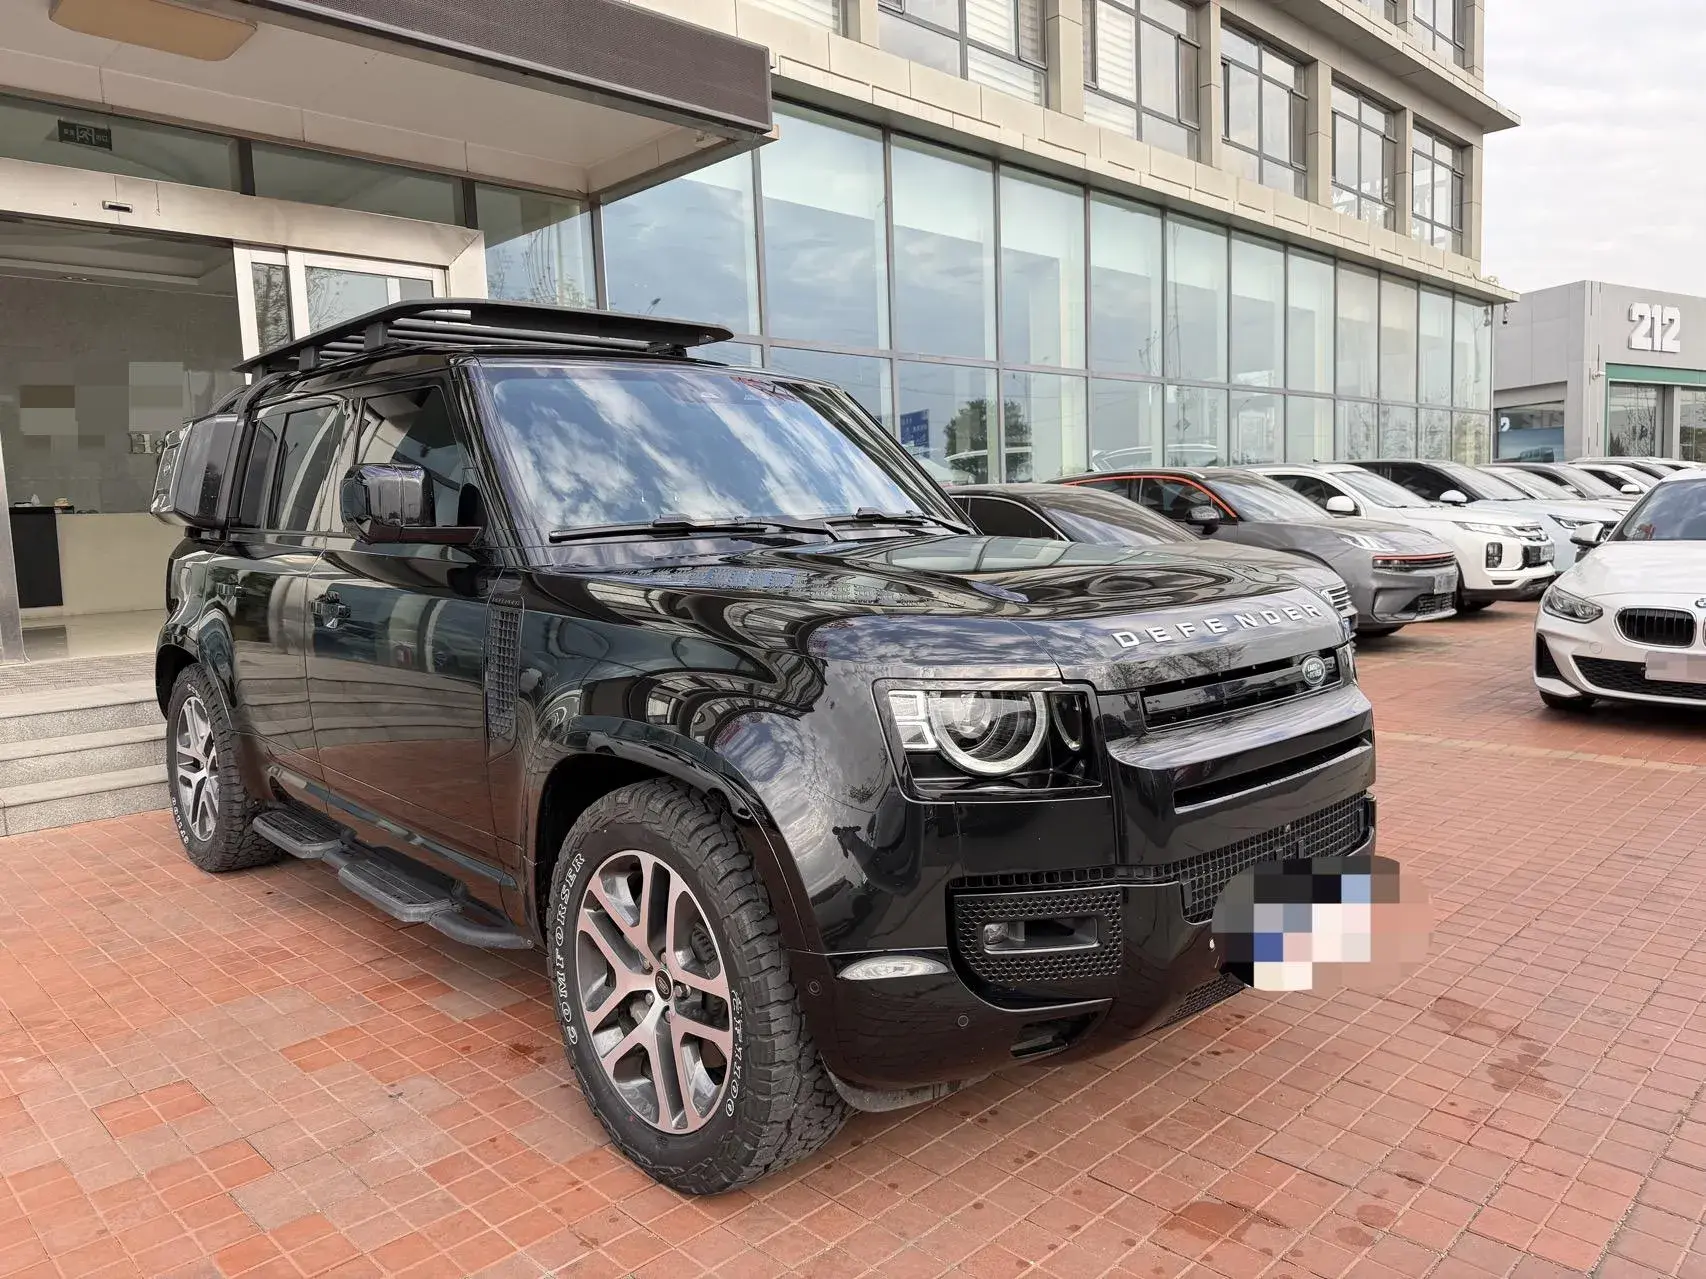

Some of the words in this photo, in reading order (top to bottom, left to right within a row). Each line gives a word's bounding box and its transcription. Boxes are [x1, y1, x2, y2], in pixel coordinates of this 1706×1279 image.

[1627, 302, 1681, 353] 212
[1112, 604, 1323, 648] DEFENDER
[555, 853, 585, 1045] COMFORSER
